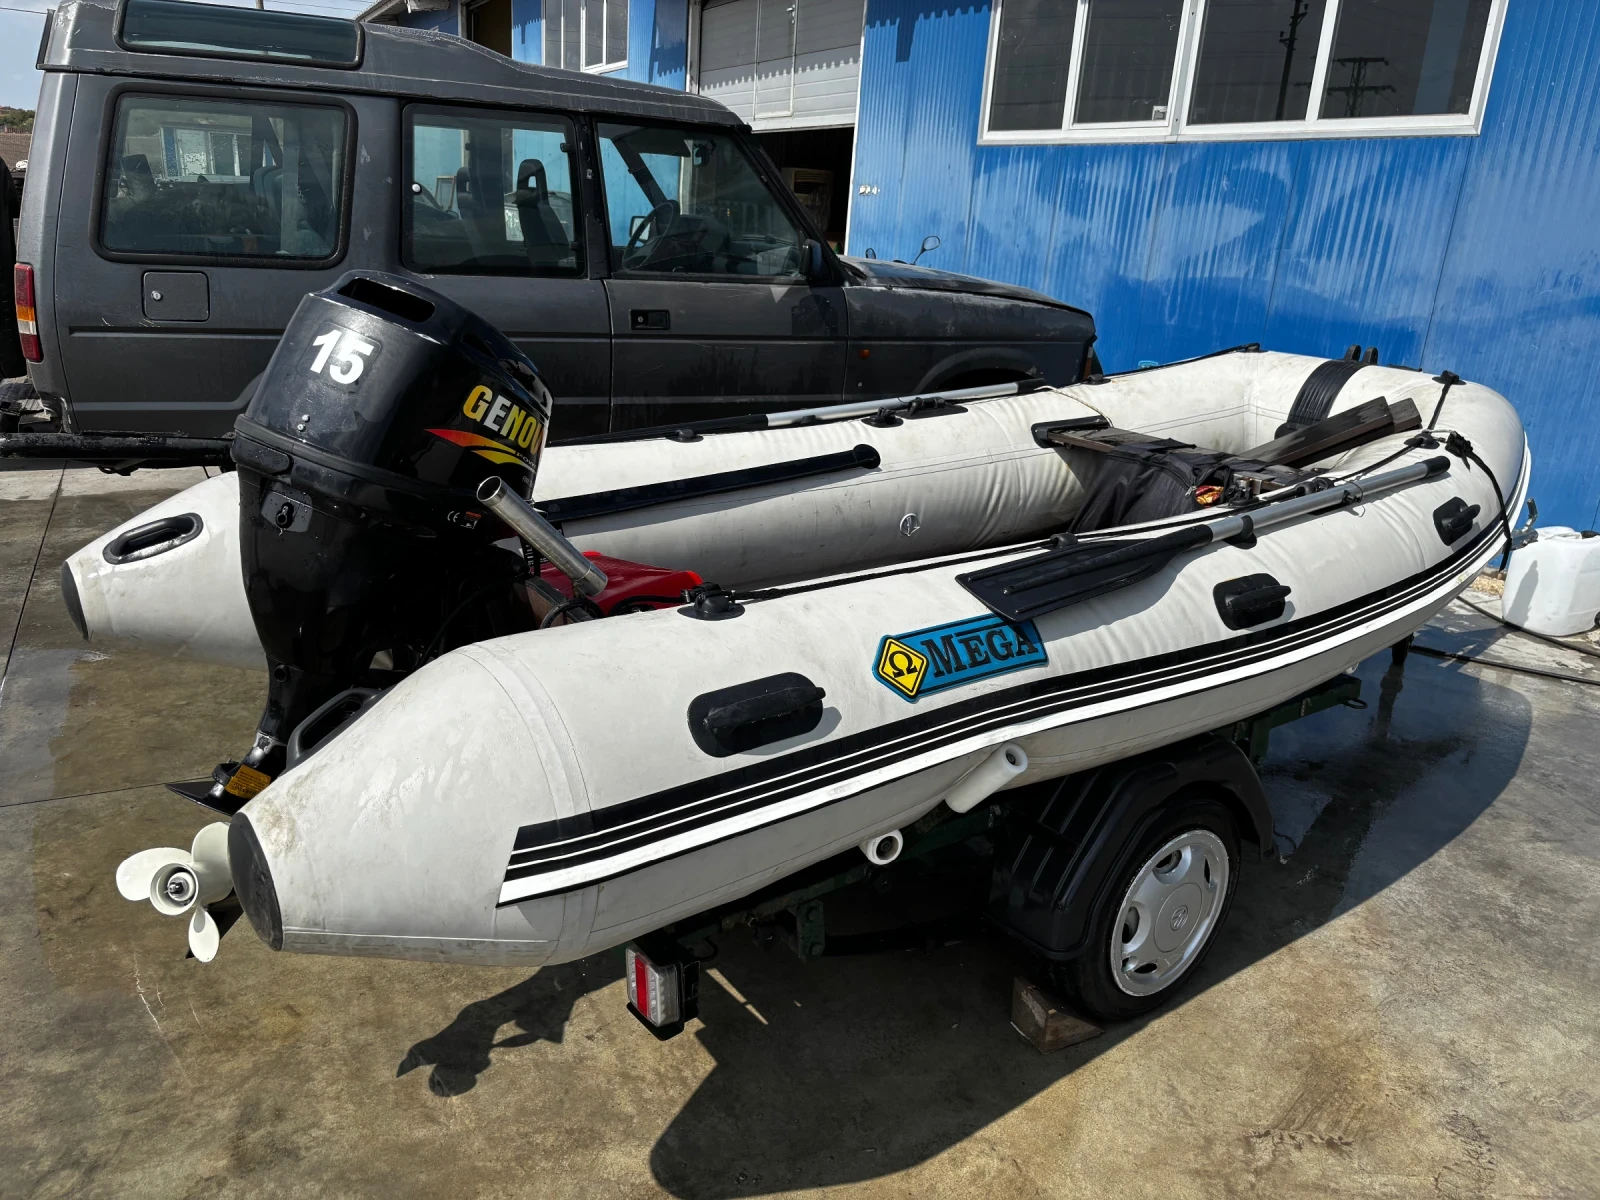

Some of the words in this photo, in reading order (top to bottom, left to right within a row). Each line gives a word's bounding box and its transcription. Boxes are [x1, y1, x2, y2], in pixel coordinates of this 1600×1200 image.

[310, 329, 374, 384] 15
[463, 385, 544, 456] GENOV
[920, 625, 1039, 679] MEGA
